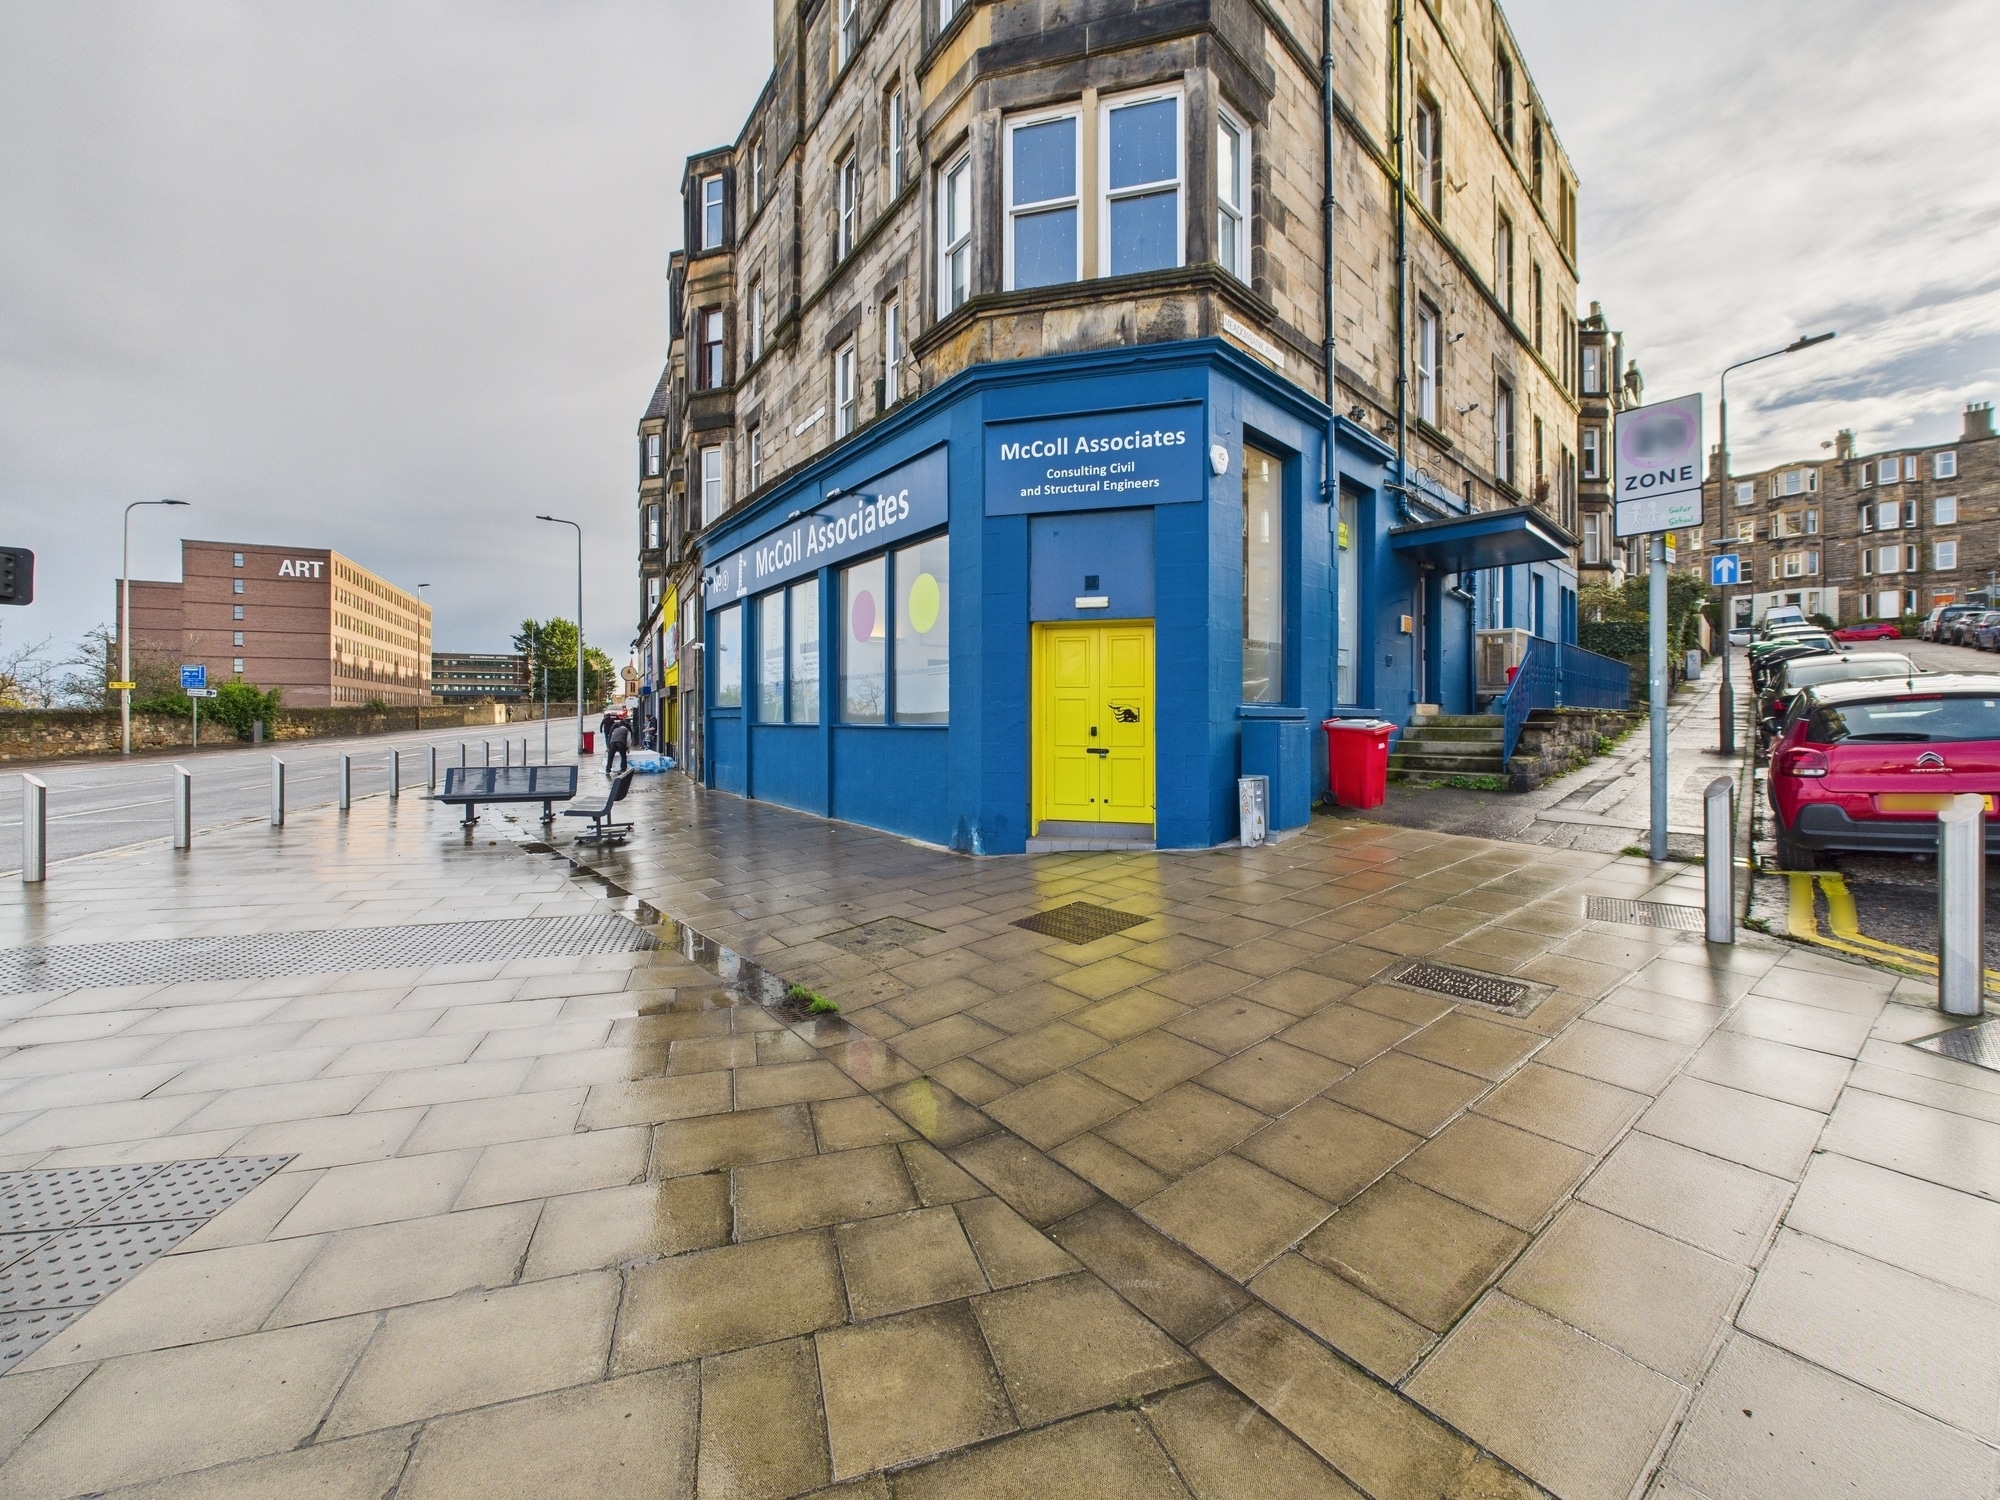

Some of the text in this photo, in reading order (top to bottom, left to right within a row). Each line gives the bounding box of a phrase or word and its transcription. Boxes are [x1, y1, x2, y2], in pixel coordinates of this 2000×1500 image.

[1001, 430, 1186, 461] McColl Associates
[1046, 462, 1135, 479] Consulting Civil
[1625, 465, 1693, 491] ZONE
[1020, 477, 1160, 496] and Structural Engineers
[1668, 506, 1692, 514] Safer
[1668, 514, 1694, 526] School
[756, 489, 910, 578] McColl Associates
[278, 559, 325, 578] ART
